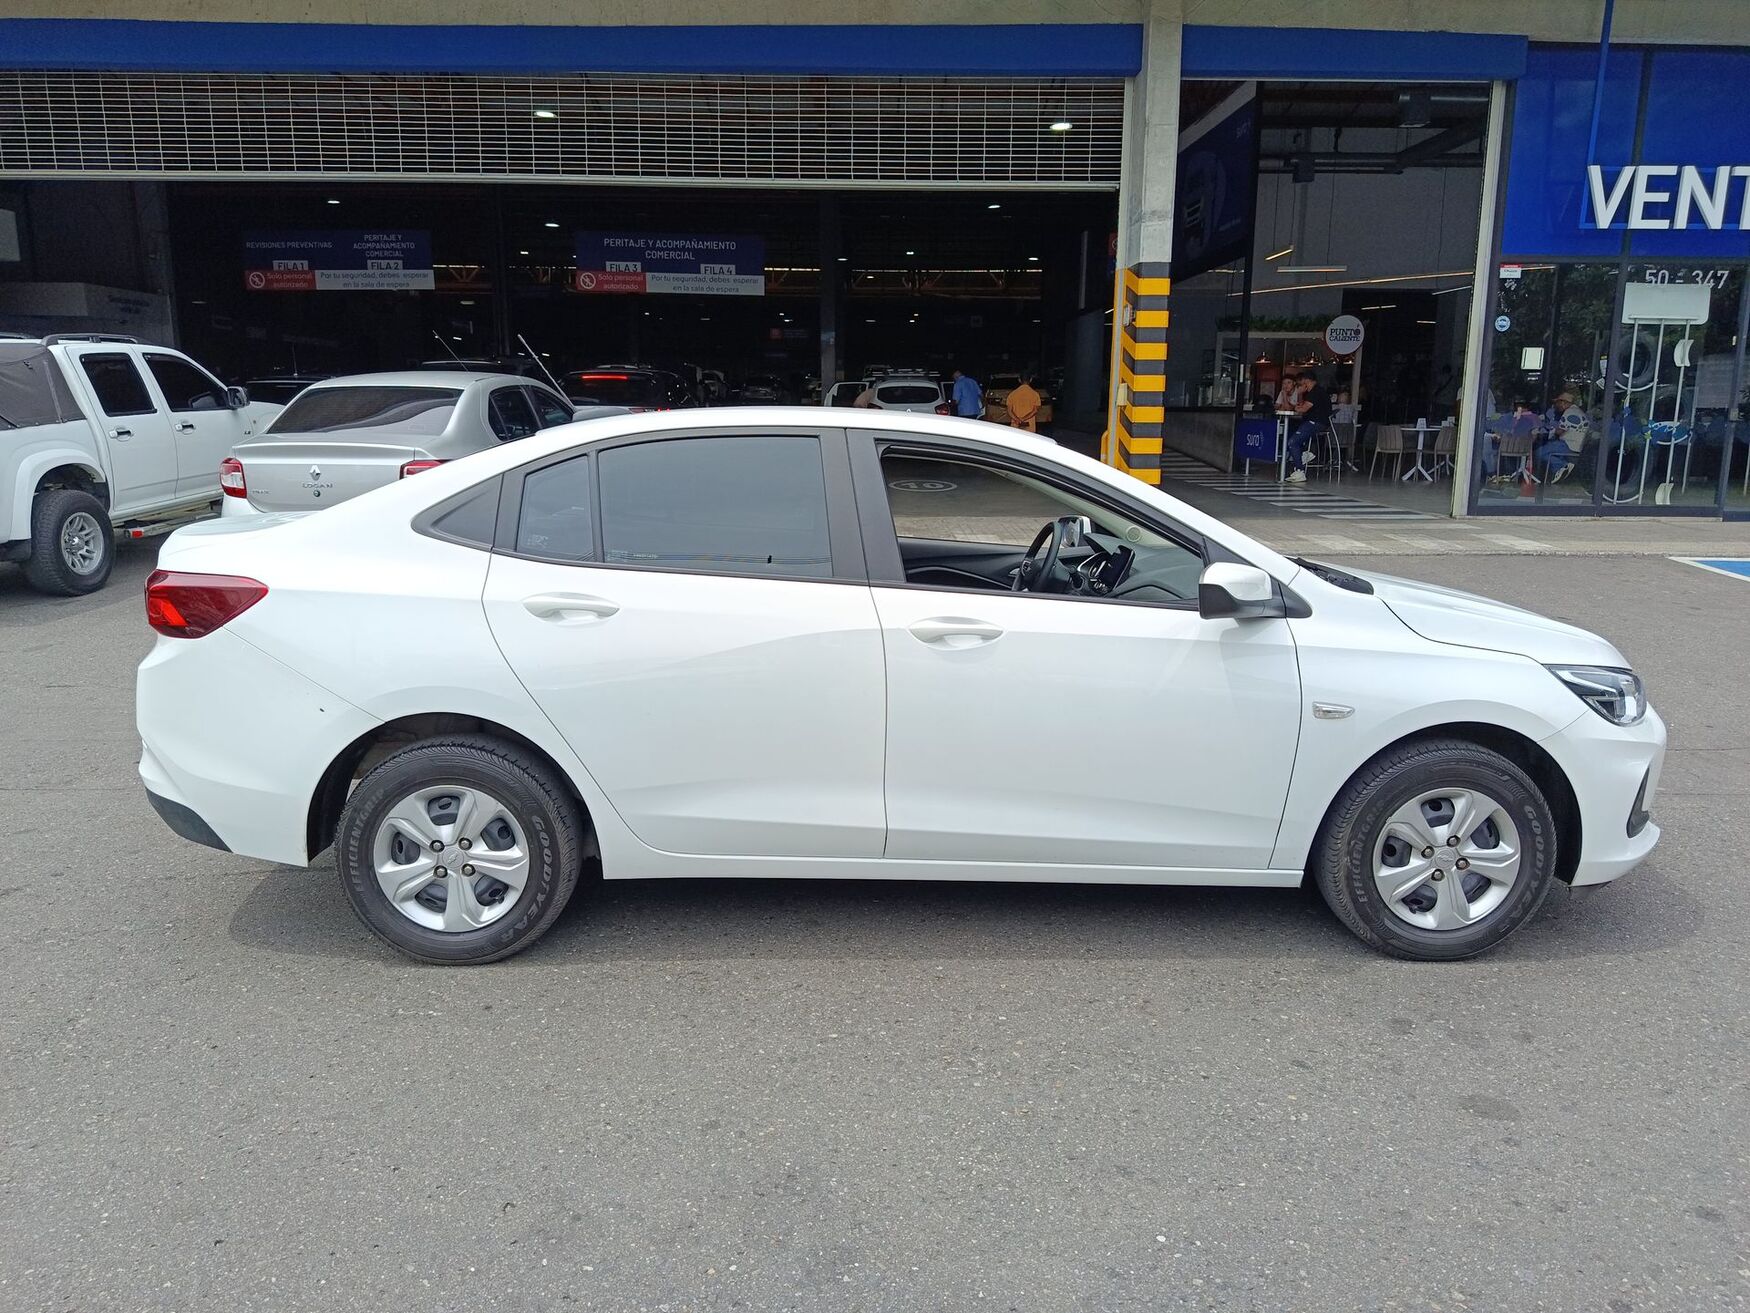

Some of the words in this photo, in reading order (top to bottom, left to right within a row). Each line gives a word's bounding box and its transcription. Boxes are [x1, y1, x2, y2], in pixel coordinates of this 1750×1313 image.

[246, 241, 285, 249] REVISIONES
[286, 241, 332, 249] PREVENTIVAS
[353, 241, 416, 250] ACOMPAÑAMIENTO
[603, 238, 646, 248] PERITAJE
[647, 239, 654, 248] Y
[656, 238, 736, 250] ACOMPAÑAMIENTO
[365, 250, 404, 258] COMERCIAL
[645, 250, 696, 260] COMERCIAL
[278, 262, 298, 271] FILA
[371, 262, 391, 270] FILA
[393, 262, 400, 270] 2
[610, 263, 630, 272] FILA
[632, 264, 638, 272] 3
[704, 266, 724, 275] FILA
[726, 266, 732, 275] 4
[598, 273, 613, 281] Solo
[614, 274, 643, 283] personal
[651, 274, 663, 282] Por
[1645, 269, 1669, 285] 50
[1692, 270, 1730, 289] 347
[603, 282, 639, 290] autorizado
[1329, 327, 1361, 336] PUNTO
[1508, 804, 1545, 919] GOODYEA
[499, 815, 553, 942] GOODYEAR
